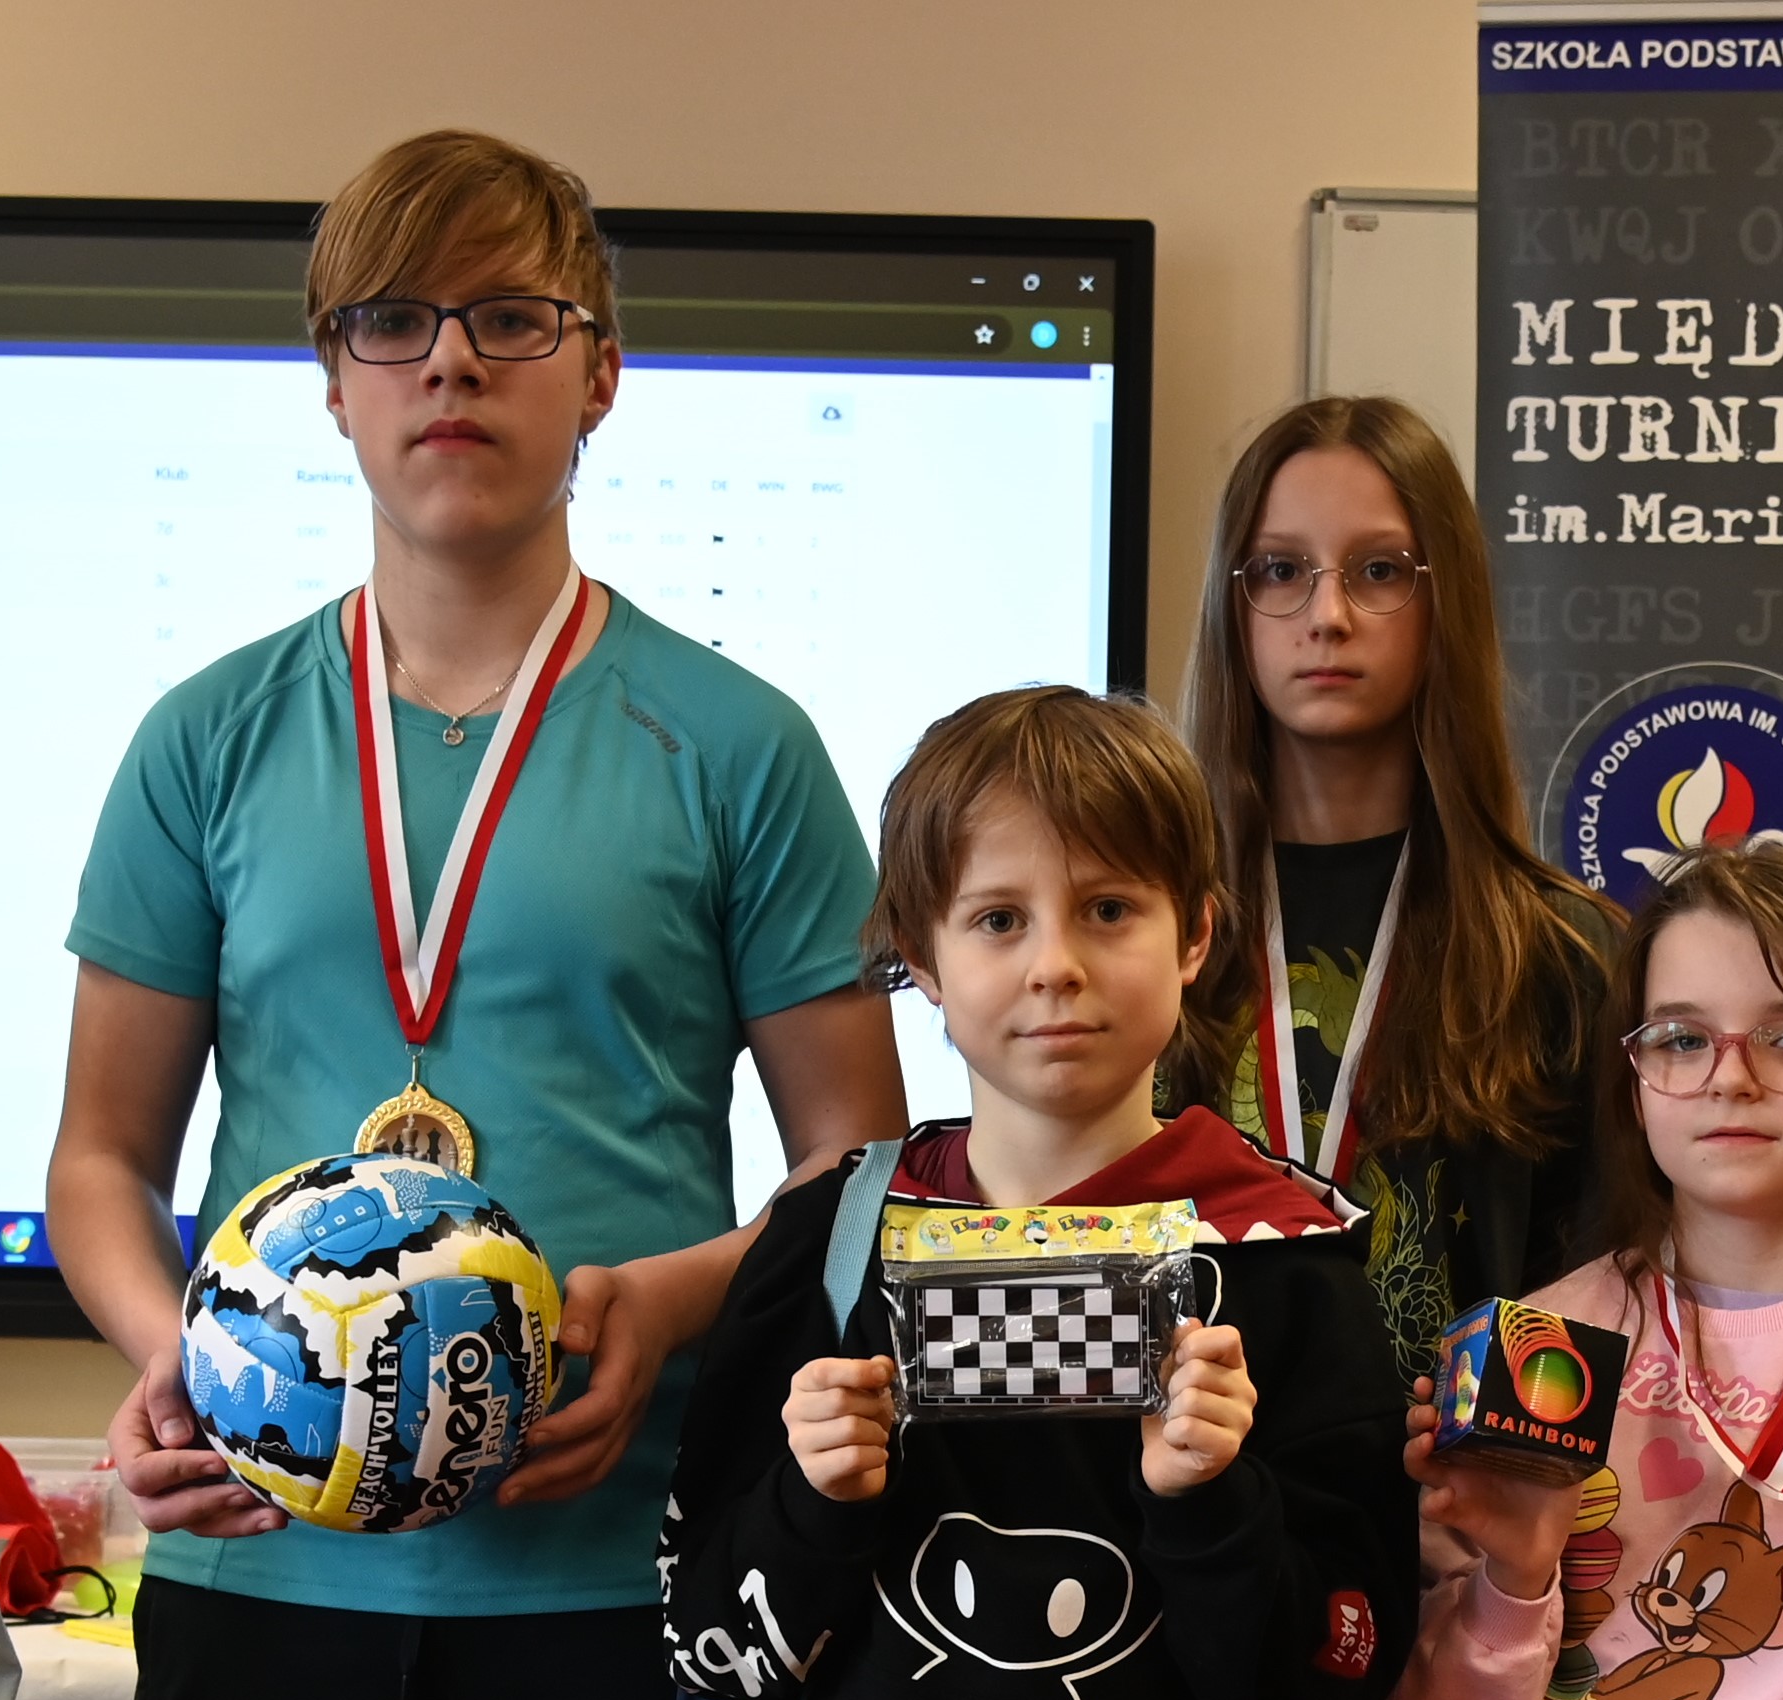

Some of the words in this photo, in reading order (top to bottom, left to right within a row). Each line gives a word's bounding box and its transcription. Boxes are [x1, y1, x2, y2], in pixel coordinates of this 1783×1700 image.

[1491, 41, 1631, 70] SZKOŁA
[1520, 119, 1715, 178] BTCR
[1510, 206, 1709, 267] KWQJ
[1590, 699, 1744, 790] PODSTAWOWA
[1748, 709, 1777, 738] IM.
[1578, 794, 1606, 892] SZKOŁA
[1484, 1410, 1597, 1455] RAINBOW
[1331, 1604, 1359, 1663] DASH
